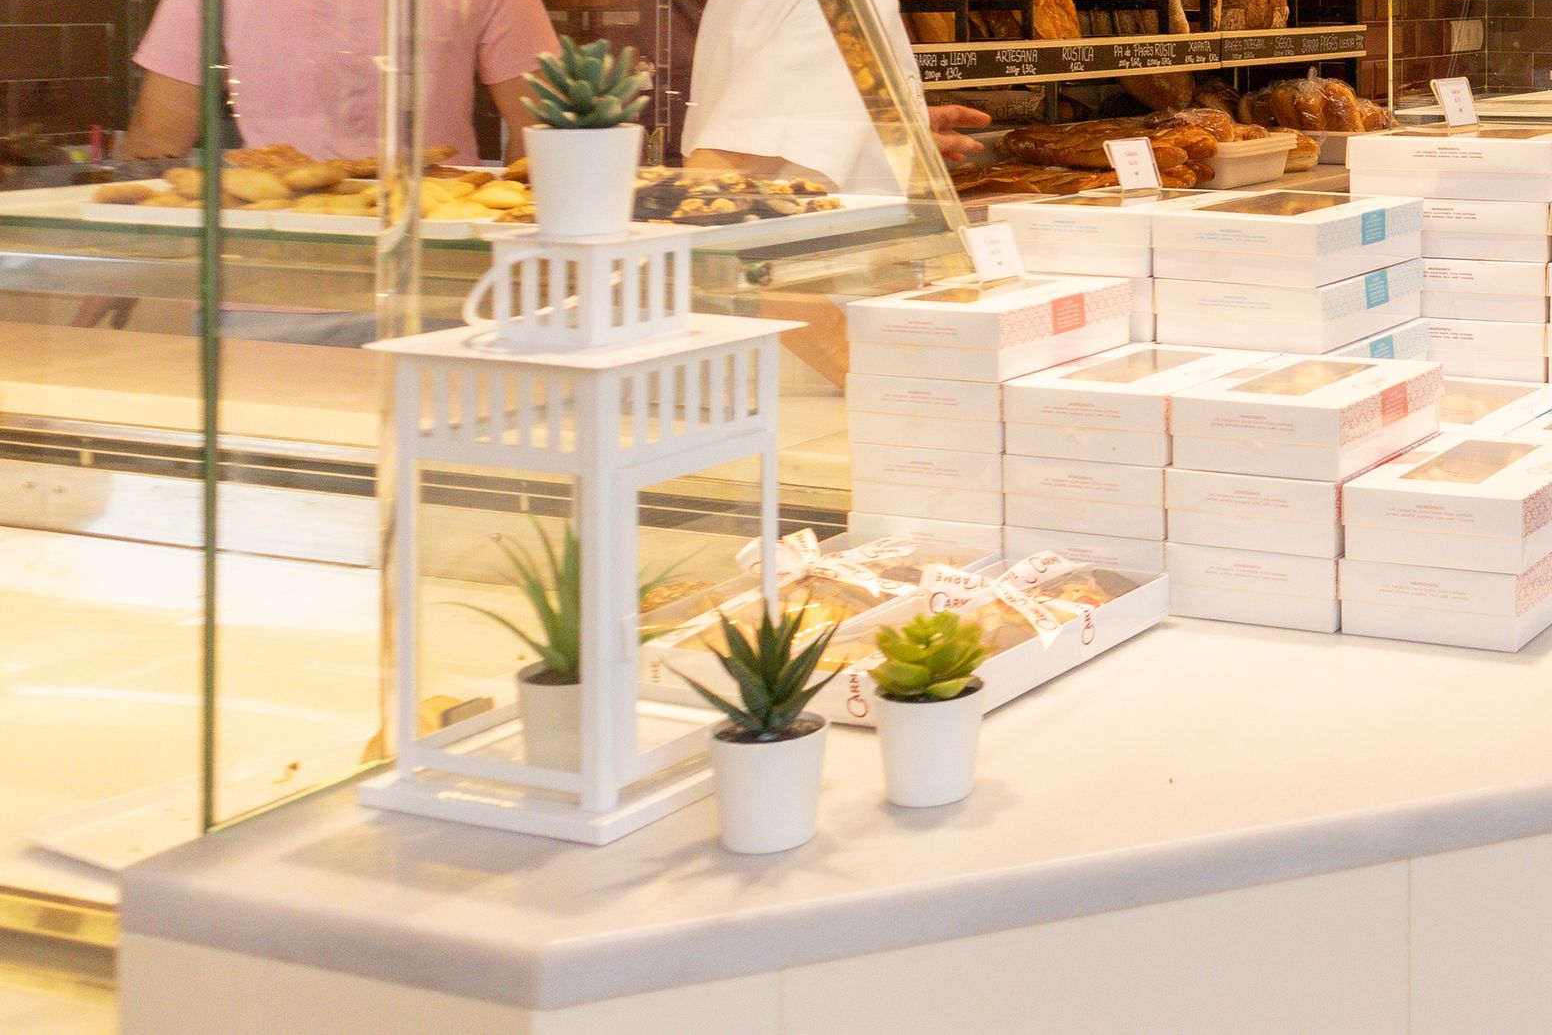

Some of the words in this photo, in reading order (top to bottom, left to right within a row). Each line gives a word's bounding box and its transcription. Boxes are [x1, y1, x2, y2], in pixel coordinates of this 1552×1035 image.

[996, 48, 1038, 63] ARTESANA
[1188, 40, 1212, 53] XAPATA
[929, 591, 973, 614] CARM
[846, 674, 868, 718] CARM
